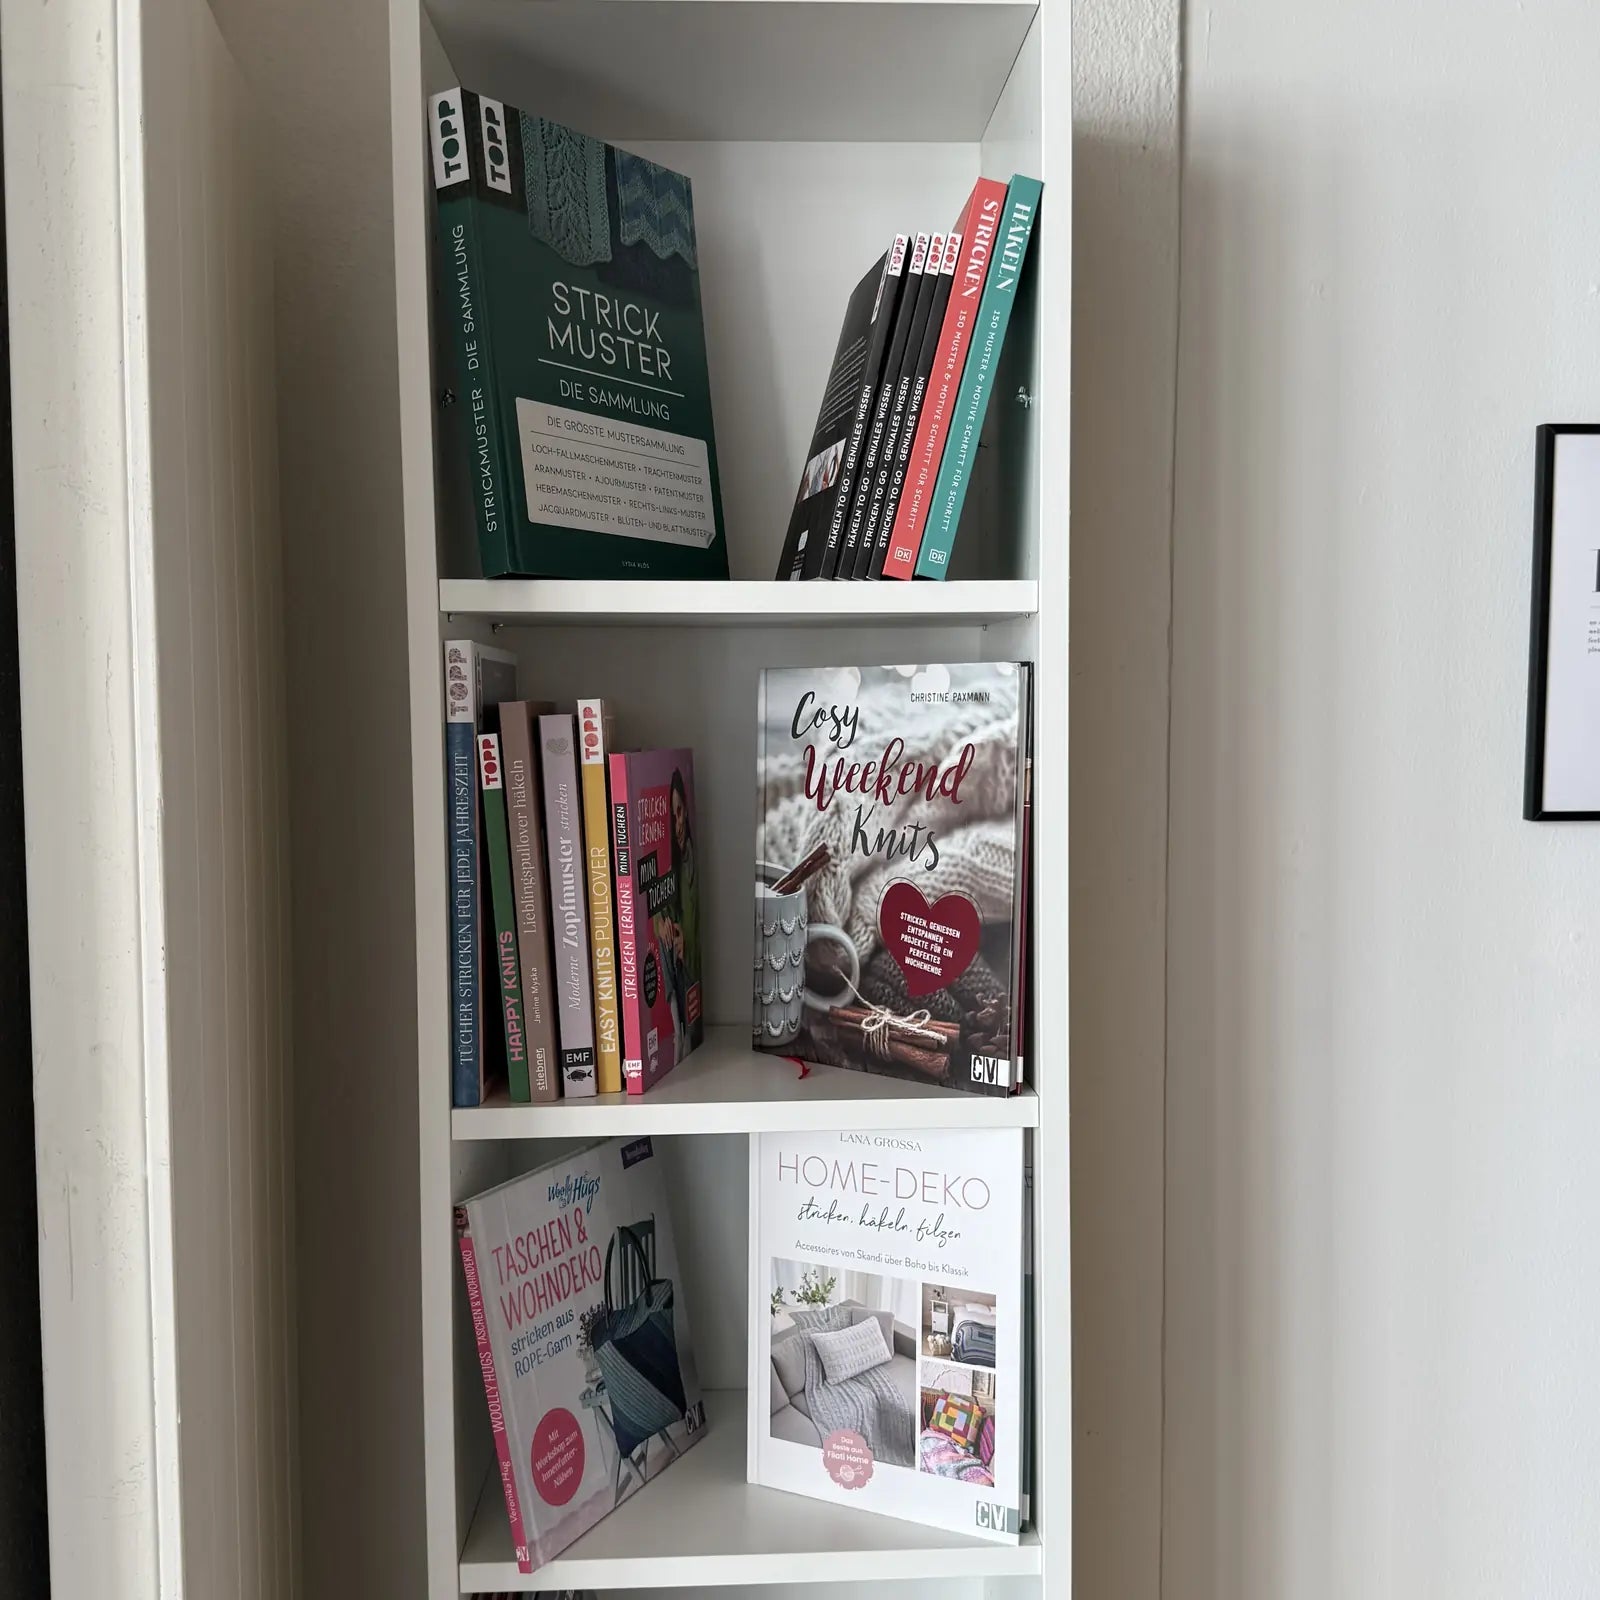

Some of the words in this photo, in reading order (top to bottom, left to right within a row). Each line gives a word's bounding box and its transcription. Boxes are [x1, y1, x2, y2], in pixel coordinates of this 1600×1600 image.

[438, 100, 461, 179] TOPP
[485, 106, 506, 183] TOPP
[890, 237, 905, 272] TOPP
[911, 235, 927, 270] TOPP
[927, 236, 943, 270] TOPP
[943, 236, 958, 270] TOPP
[961, 198, 999, 300] STRICKEN
[995, 202, 1032, 293] HÄKELN
[452, 224, 475, 334] SAMMLUNG
[552, 281, 663, 343] STRICK
[956, 309, 968, 328] 150
[990, 309, 1001, 329] 150
[466, 340, 479, 370] DIE
[547, 315, 673, 381] MUSTER
[946, 331, 962, 370] MUSTER
[980, 331, 996, 370] MUSTER
[910, 376, 926, 412] WISSEN
[944, 372, 952, 382] &
[977, 372, 985, 382] &
[560, 379, 584, 401] DIE
[588, 386, 670, 421] SAMMLUNG
[857, 384, 872, 421] WISSEN
[933, 384, 949, 421] MOTIVE
[967, 384, 983, 422] MOTIVE
[547, 415, 562, 428] DIE
[607, 430, 685, 455] MUSTERSAMMLUNG
[846, 423, 863, 469] GENIALES
[856, 494, 866, 507] TO
[861, 477, 870, 492] GO
[866, 421, 883, 468] GENIALES
[877, 383, 893, 419] WISSEN
[899, 414, 916, 461] GENIALES
[923, 424, 939, 465] SCHRITT
[957, 424, 973, 466] SCHRITT
[471, 387, 497, 532] STRICKMUSTER
[531, 443, 636, 472] LOCH-FALLMASCHENMUSTER
[643, 466, 703, 485] TRACHTENMUSTER
[863, 502, 880, 548] STRICKEN
[874, 487, 884, 500] TO
[879, 470, 888, 485] GO
[884, 414, 901, 461] GENIALES
[895, 376, 911, 412] WISSEN
[893, 470, 903, 485] GO
[534, 464, 586, 480] ARANMUSTER
[595, 475, 646, 492] AJOURMUSTER
[654, 486, 704, 502] PATENTMUSTER
[536, 483, 621, 506] HEBEMASCHENMUSTER
[837, 495, 847, 508] TO
[841, 478, 850, 493] GO
[889, 487, 899, 500] TO
[538, 504, 609, 522] JACQUARDMUSTER
[879, 502, 896, 548] STRICKEN
[907, 488, 923, 531] SCHRITT
[941, 489, 957, 532] SCHRITT
[896, 549, 910, 561] DK
[931, 550, 944, 562] DK
[448, 647, 468, 717] TOPP
[910, 692, 949, 703] CHRISTINE
[952, 692, 990, 702] PAXMANN
[582, 706, 599, 760] TOPP
[791, 691, 859, 750] Cosy
[482, 738, 498, 786] TOPP
[803, 737, 975, 811] Weekend
[454, 753, 473, 845] JAHRESZEIT
[510, 759, 527, 808] häkeln
[555, 783, 570, 831] stricken
[637, 794, 667, 822] STRICKEN
[851, 803, 940, 871] Knits
[456, 848, 475, 885] JEDE
[516, 812, 537, 934] Lieblingspullover
[619, 851, 628, 874] MINI
[456, 888, 472, 918] FÜR
[558, 836, 581, 948] Zopfmuster
[591, 847, 610, 941] PULLOVER
[619, 889, 634, 935] LERNEN
[900, 911, 928, 928] STRICKEN,
[929, 921, 960, 939] GENIESSEN
[900, 933, 929, 950] PROJEKTE
[930, 943, 942, 954] FÜR
[942, 947, 954, 958] EIN
[907, 925, 944, 944] ENTSPANNEN
[457, 923, 472, 997] STRICKEN
[499, 930, 518, 990] KNITS
[596, 946, 614, 1000] KNITS
[622, 941, 637, 999] STRICKEN
[904, 956, 943, 977] WOCHENENDE
[909, 947, 941, 965] PERFEKTES
[531, 967, 539, 993] Myska
[568, 955, 581, 1011] Moderne
[502, 996, 524, 1061] HAPPY
[533, 995, 541, 1024] Janine
[599, 1006, 616, 1052] EASY
[455, 1001, 473, 1065] TÜCHER
[536, 1047, 546, 1091] stiebner
[566, 1051, 590, 1063] EMF
[972, 1056, 996, 1084] CV
[839, 1132, 871, 1146] LANA
[874, 1136, 922, 1152] GROSSA
[572, 1176, 601, 1214] Hugs
[778, 1151, 990, 1210] HOME-DEKO
[491, 1213, 573, 1286] TASCHEN
[573, 1207, 589, 1243] &
[916, 1213, 961, 1248] filzen
[462, 1250, 480, 1300] WOHNDEKO
[795, 1239, 839, 1256] Accessoires
[839, 1250, 855, 1259] von
[856, 1249, 883, 1263] Skandi
[884, 1254, 902, 1266] über
[904, 1256, 926, 1270] Boho
[928, 1261, 939, 1272] bis
[941, 1264, 969, 1277] Klassik
[500, 1244, 602, 1332] WOHNDEKO
[472, 1308, 487, 1345] TASCHEN
[511, 1318, 555, 1356] stricken
[555, 1308, 574, 1330] aus
[479, 1351, 497, 1383] HUGS
[514, 1333, 573, 1379] ROPE-Garn
[485, 1384, 504, 1434] WOOLLY
[535, 1440, 566, 1472] Workshop
[565, 1430, 578, 1446] zum
[548, 1428, 559, 1443] Mit
[501, 1460, 511, 1481] Hug
[505, 1483, 518, 1524] Veronika
[977, 1502, 1005, 1531] CV
